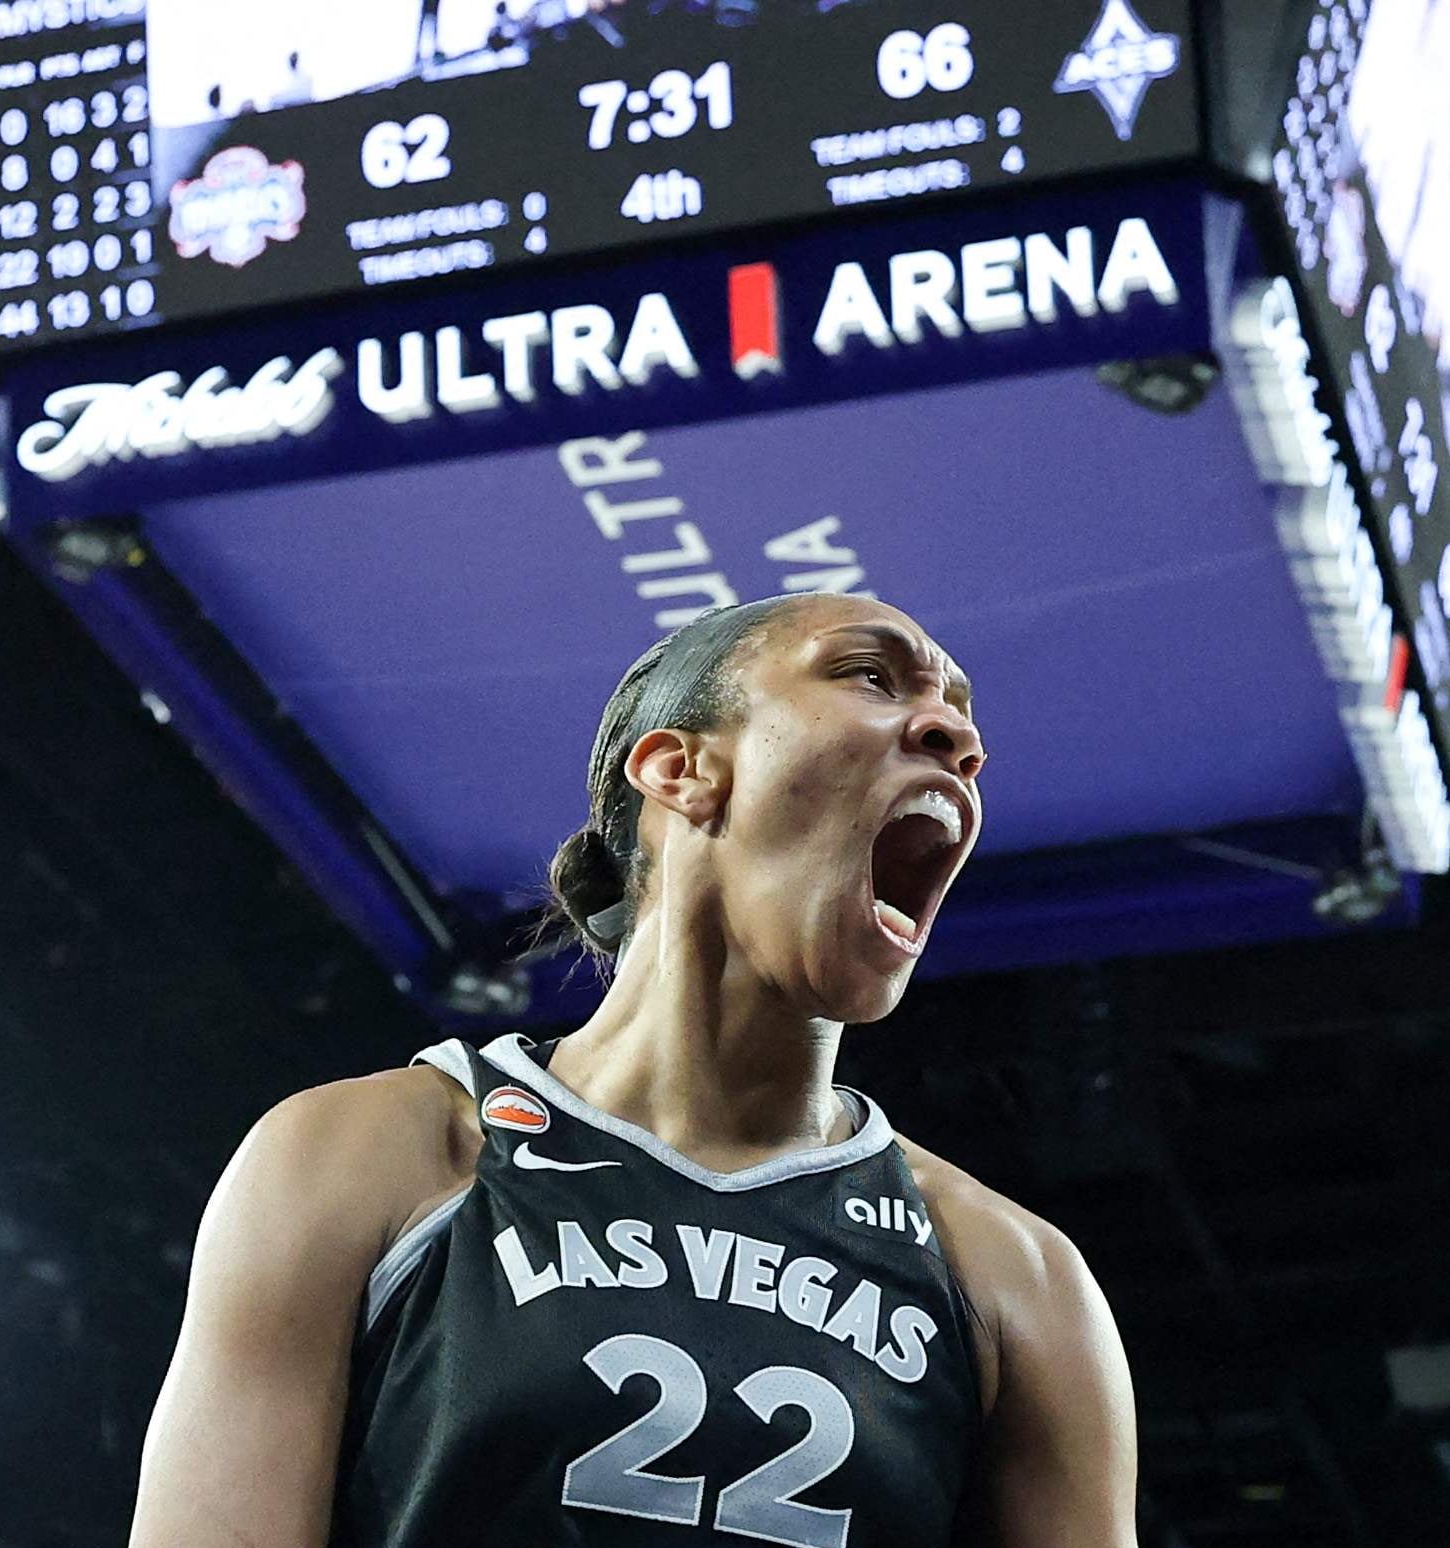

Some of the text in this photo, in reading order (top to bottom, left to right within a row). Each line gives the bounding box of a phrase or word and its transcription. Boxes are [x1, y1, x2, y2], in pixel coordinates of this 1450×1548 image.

[877, 22, 974, 99] 66
[578, 61, 733, 150] 7:31
[361, 113, 451, 189] 62
[52, 193, 79, 231] 2
[93, 185, 120, 224] 2
[620, 169, 702, 223] 4th
[130, 228, 152, 264] 1
[357, 292, 698, 423] ULTRA
[813, 217, 1178, 355] ARENA
[844, 1196, 933, 1247] ally
[492, 1218, 939, 1384] LAS VEGAS
